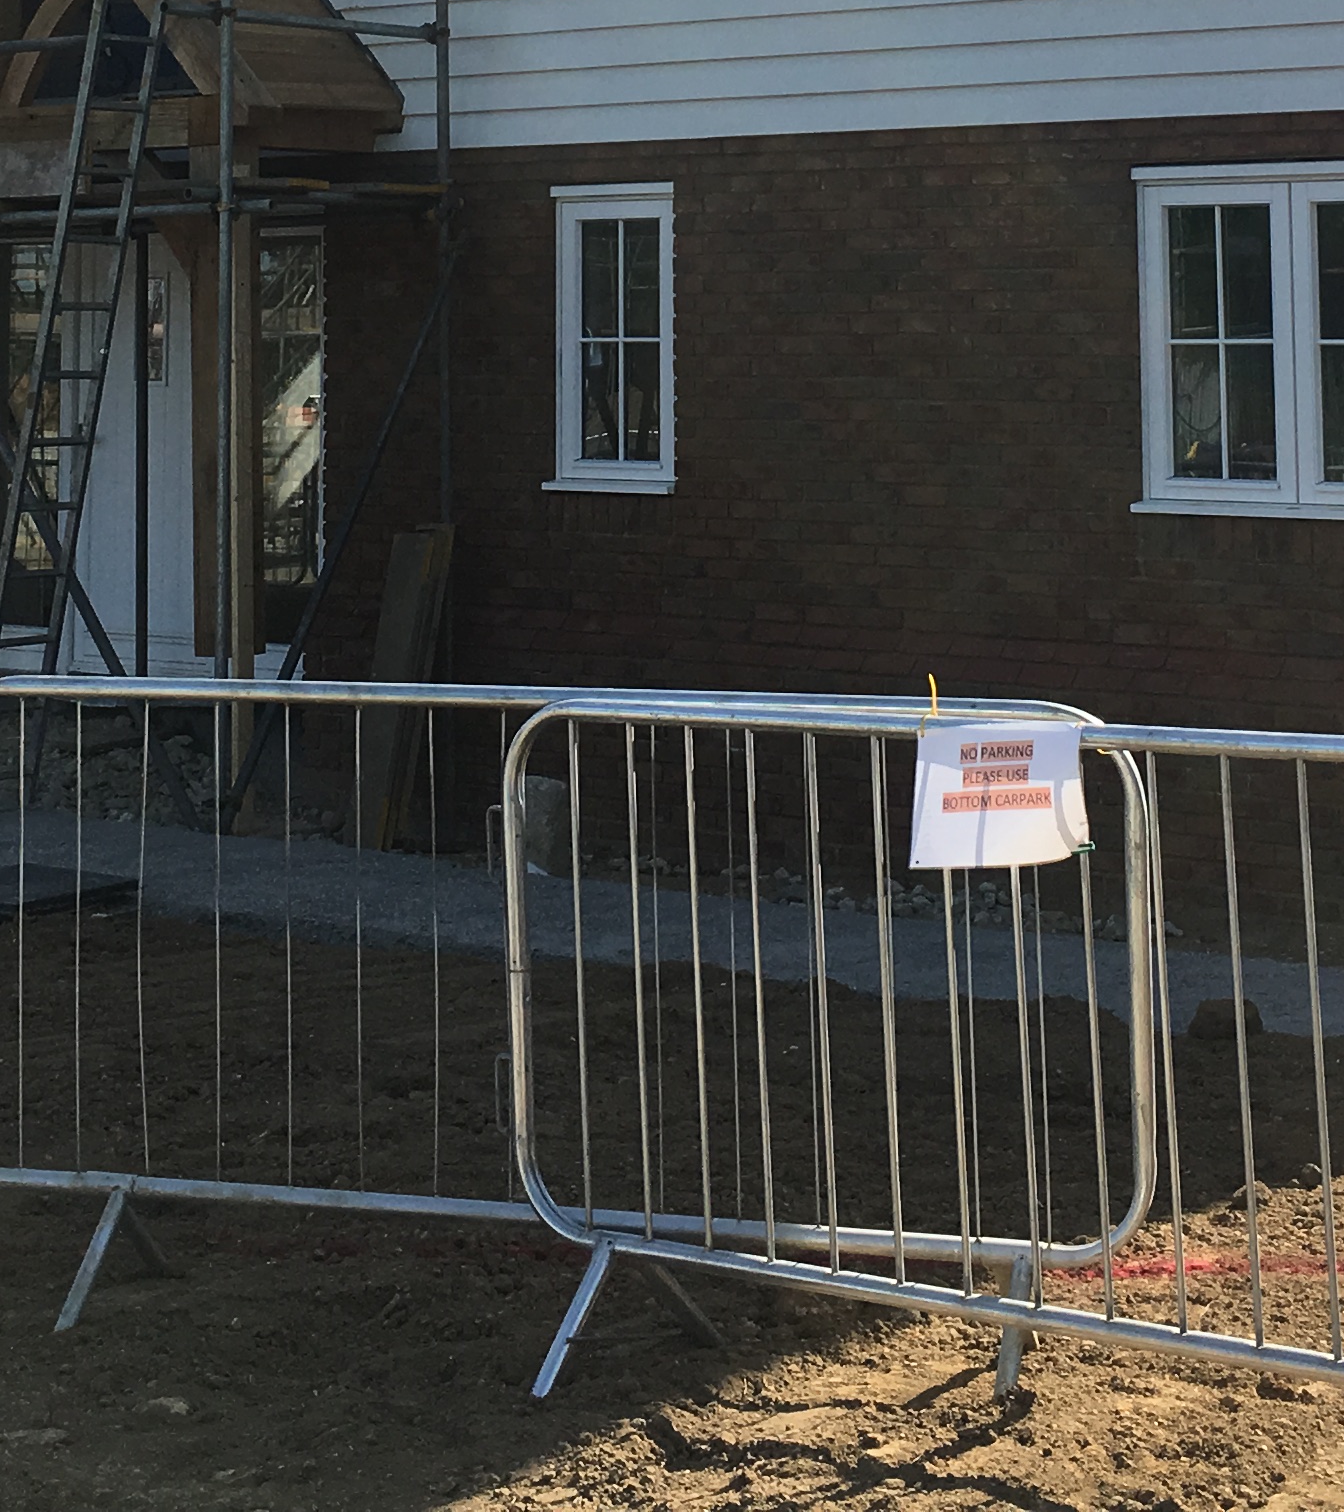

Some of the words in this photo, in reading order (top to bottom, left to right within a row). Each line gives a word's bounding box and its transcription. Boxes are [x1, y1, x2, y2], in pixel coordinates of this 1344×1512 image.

[960, 747, 978, 761] NO
[980, 744, 1034, 760] PARKING
[963, 770, 1003, 785] PLEASE
[1006, 768, 1029, 782] USE
[942, 795, 992, 810] BOTTOM
[995, 791, 1052, 807] CARPARK
